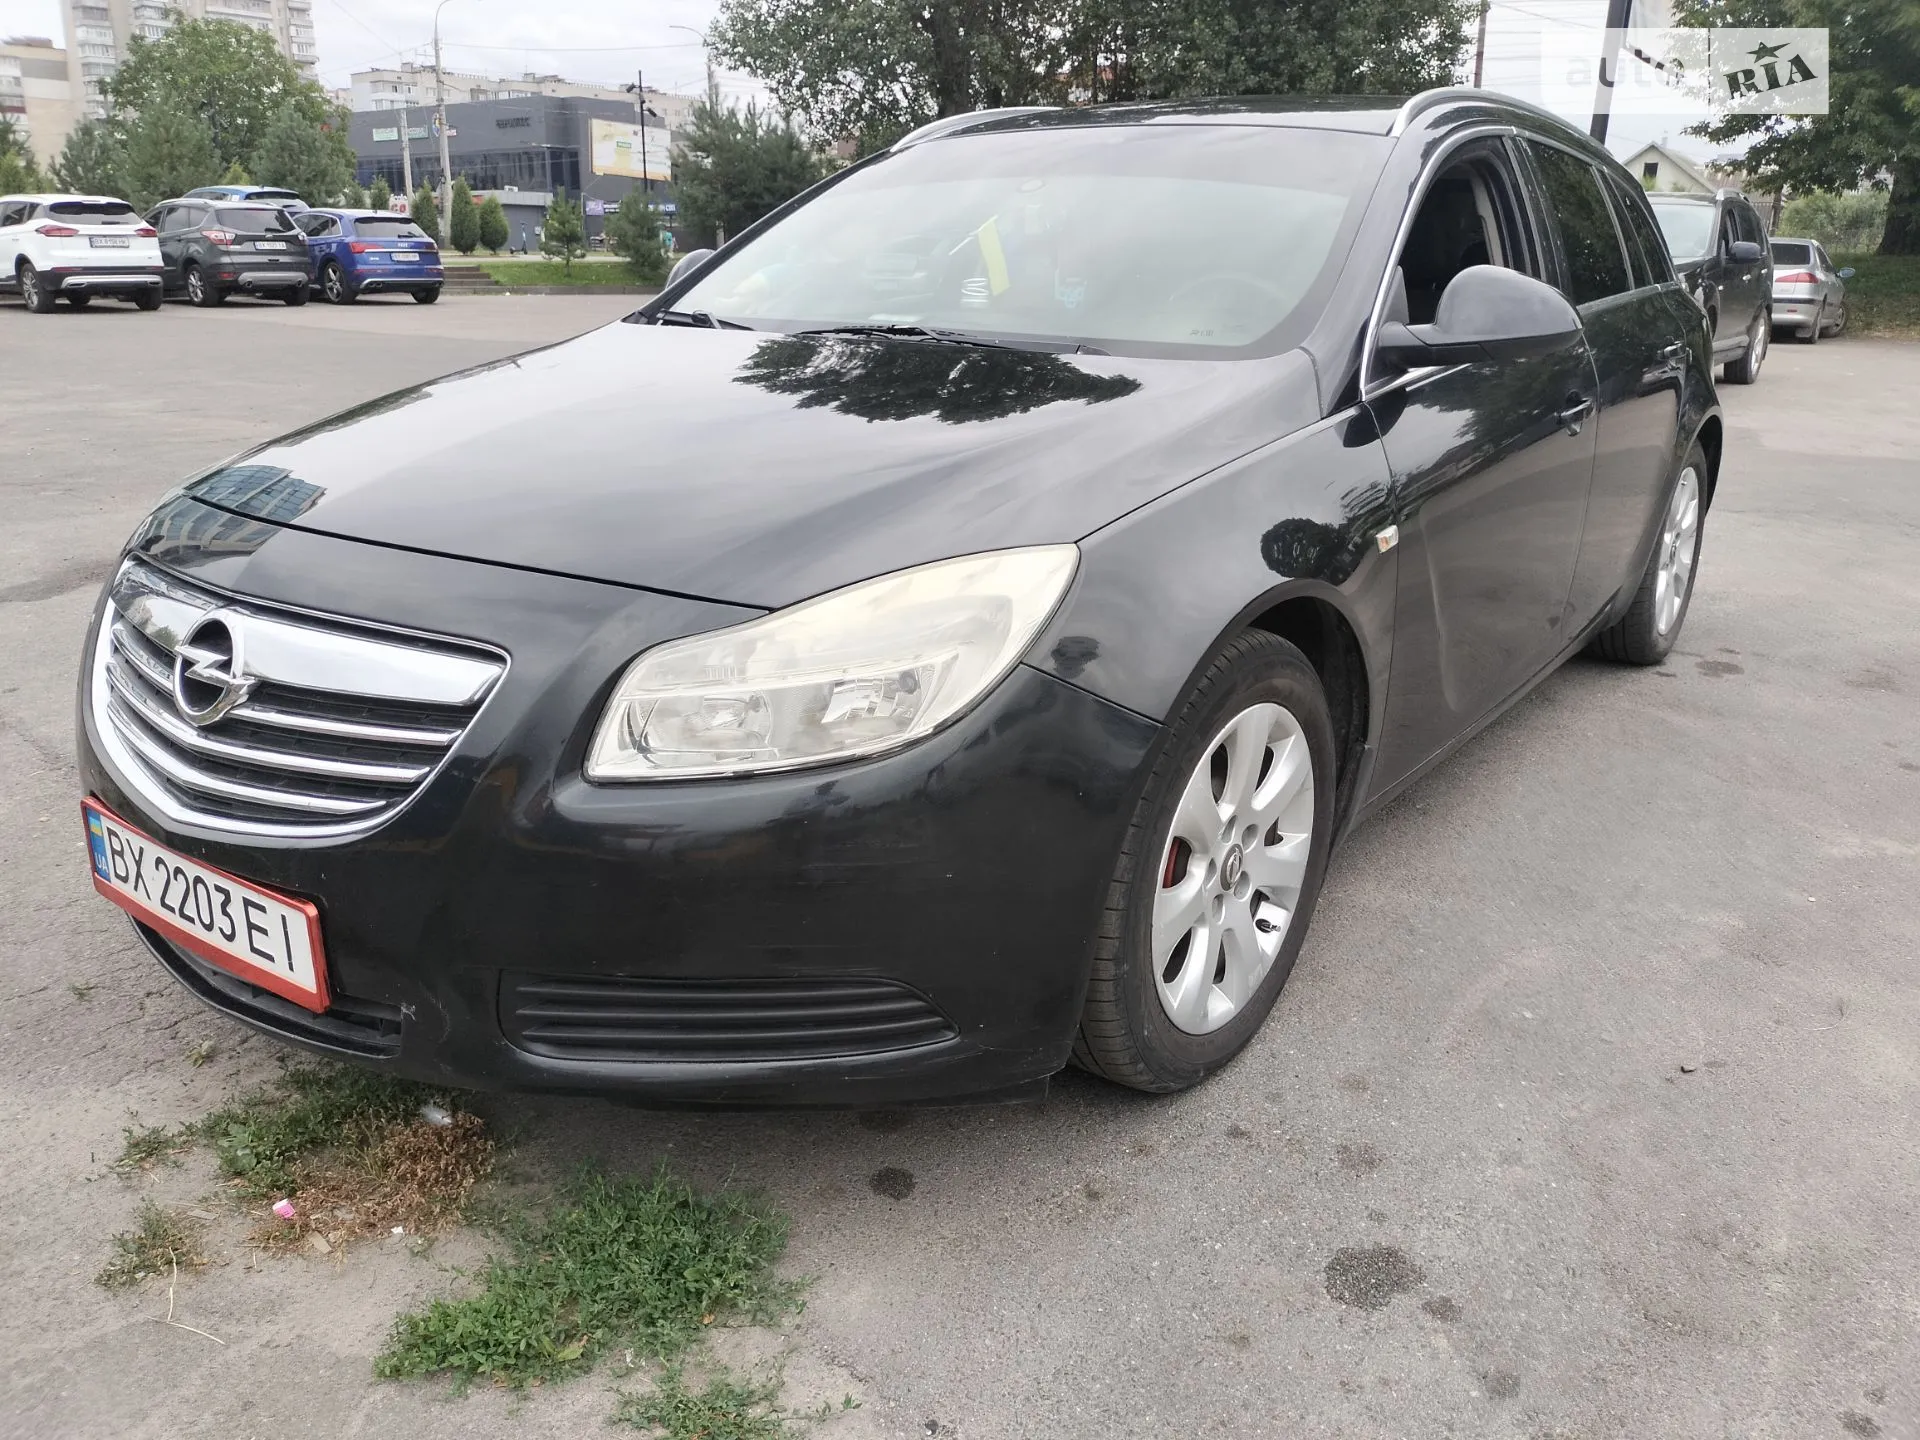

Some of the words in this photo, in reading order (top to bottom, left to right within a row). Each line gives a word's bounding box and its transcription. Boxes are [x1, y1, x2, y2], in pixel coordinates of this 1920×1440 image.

[95, 853, 109, 873] UA
[105, 825, 152, 902] BX
[154, 856, 237, 943] 2203
[241, 895, 296, 973] EI
